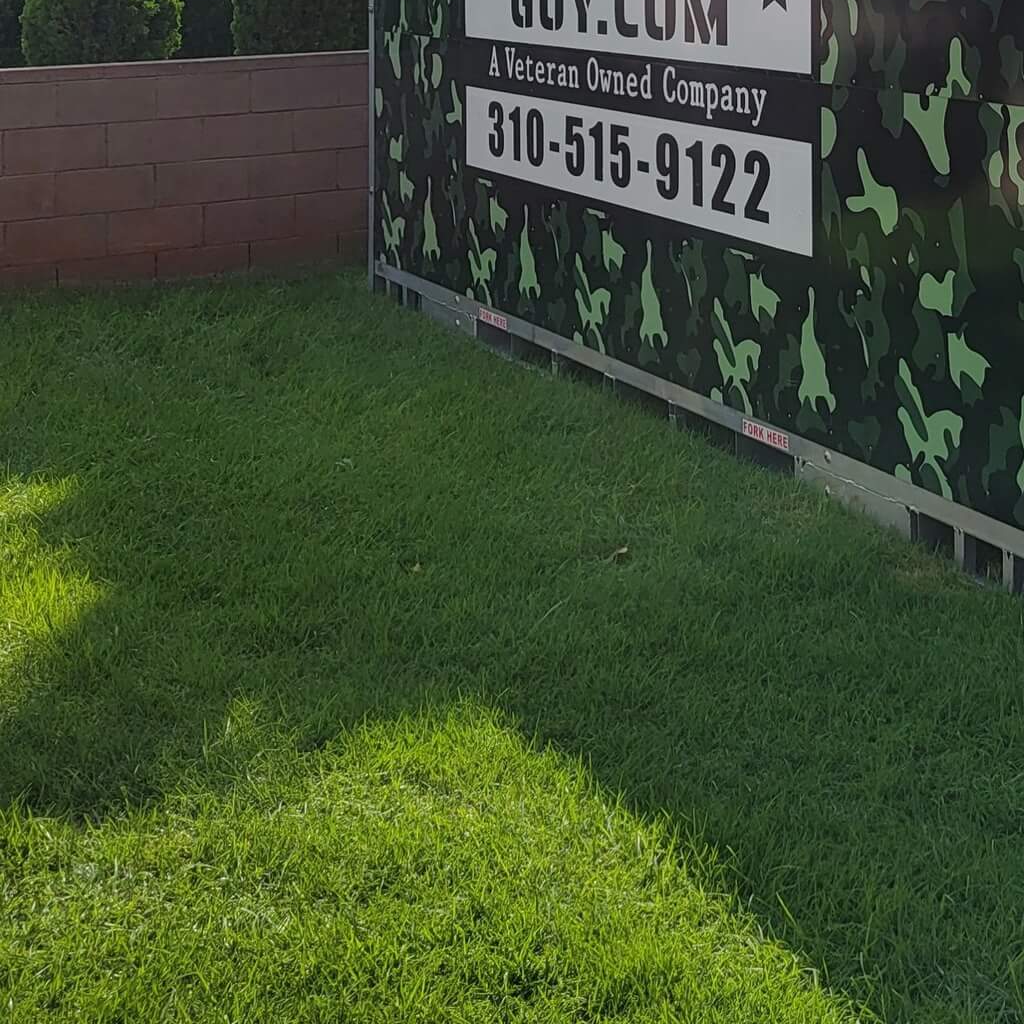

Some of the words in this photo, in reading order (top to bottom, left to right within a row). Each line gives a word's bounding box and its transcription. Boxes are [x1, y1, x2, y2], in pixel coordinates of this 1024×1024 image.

[488, 45, 500, 77] A
[504, 47, 580, 89] Veteran
[586, 56, 653, 100] Owned
[662, 66, 767, 127] Company
[488, 101, 770, 224] 310-515-9122
[744, 421, 764, 441] FORK
[767, 429, 788, 449] HERE
